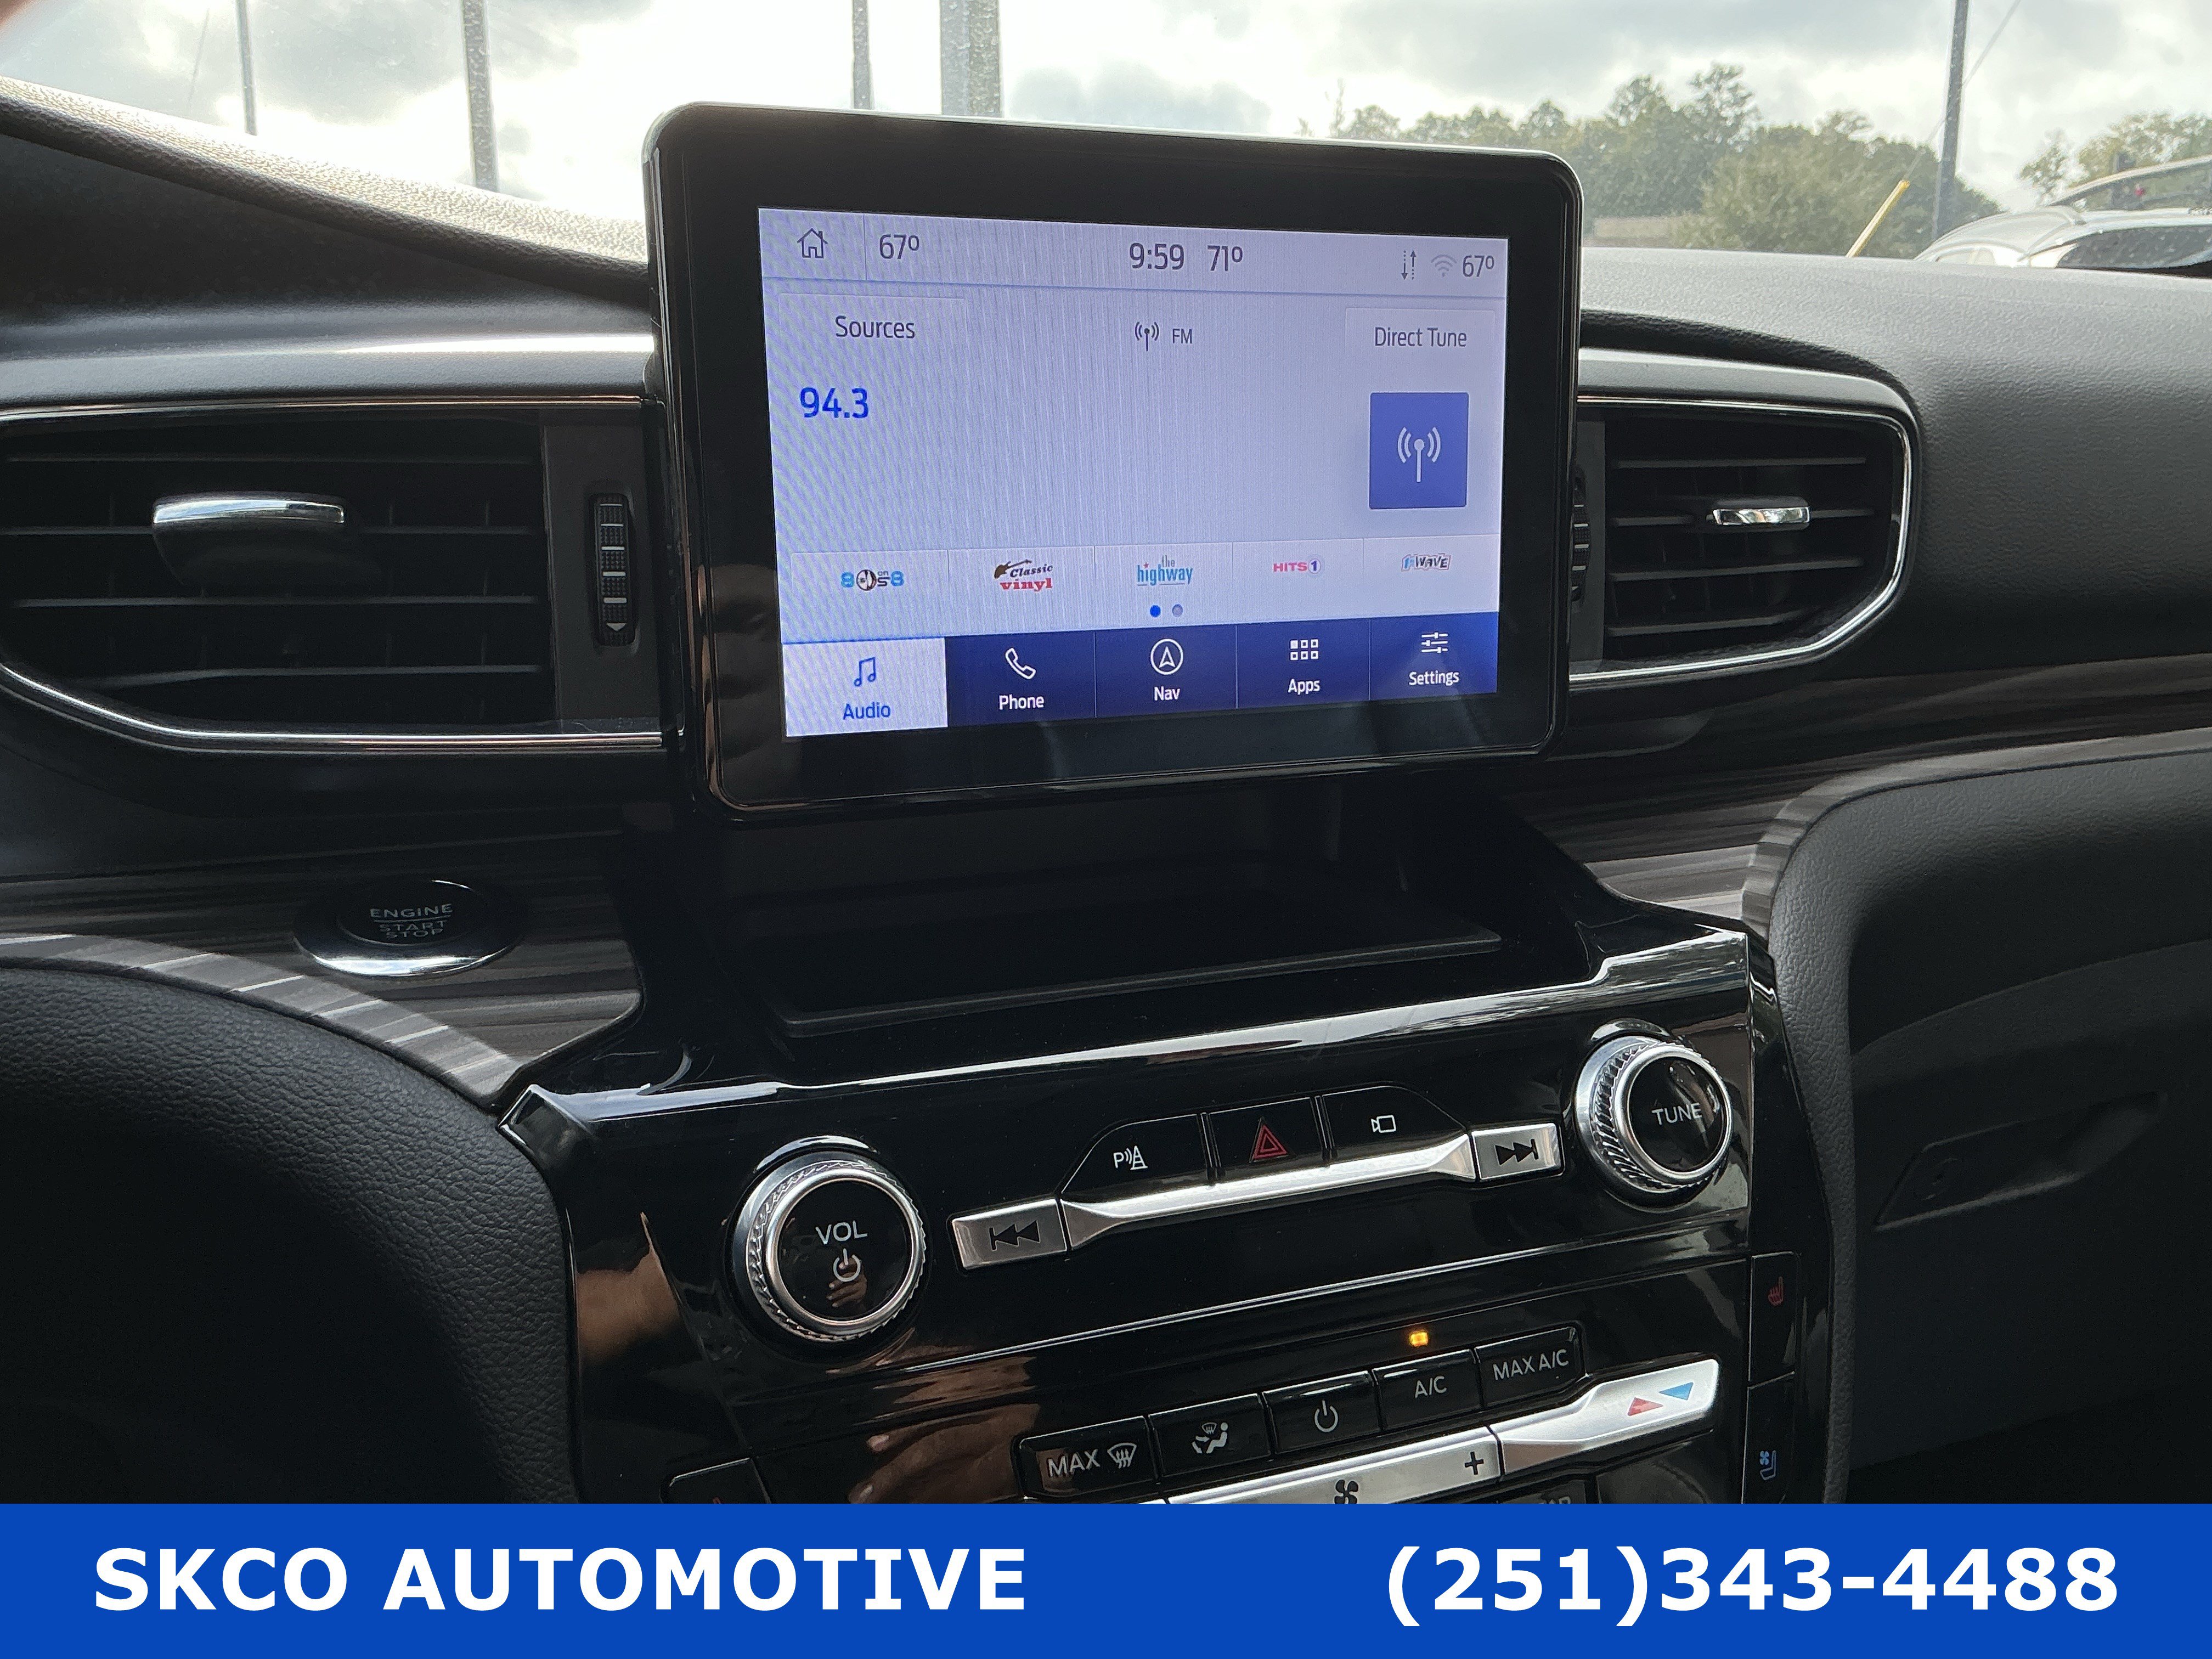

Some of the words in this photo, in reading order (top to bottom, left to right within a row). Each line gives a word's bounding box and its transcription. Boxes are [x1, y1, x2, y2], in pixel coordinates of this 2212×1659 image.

[879, 233, 920, 260] 67°
[1128, 242, 1185, 270] 9:59
[1207, 245, 1243, 272] 71°
[835, 314, 916, 339] Sources
[1172, 329, 1193, 345] FM
[1374, 326, 1423, 348] Direct
[1427, 328, 1468, 348] Tune
[800, 387, 870, 418] 94.3
[1161, 555, 1175, 567] the
[1415, 555, 1448, 568] WAVE
[1010, 563, 1053, 578] Classic
[1137, 563, 1193, 585] highway
[1000, 578, 1053, 592] vinyl
[1288, 678, 1320, 695] Apps
[1408, 668, 1460, 687] Settings
[998, 694, 1044, 710] Phone
[1154, 685, 1180, 702] Nav
[842, 702, 891, 720] Audio
[370, 904, 453, 917] ENGINE
[379, 920, 445, 933] START
[386, 928, 444, 939] STOP
[1651, 1101, 1703, 1126] TUNE
[815, 1220, 868, 1246] VOL
[1493, 1354, 1536, 1382] MAX
[1538, 1347, 1570, 1372] A/C
[1414, 1376, 1447, 1398] A/C
[1048, 1449, 1101, 1477] MAX
